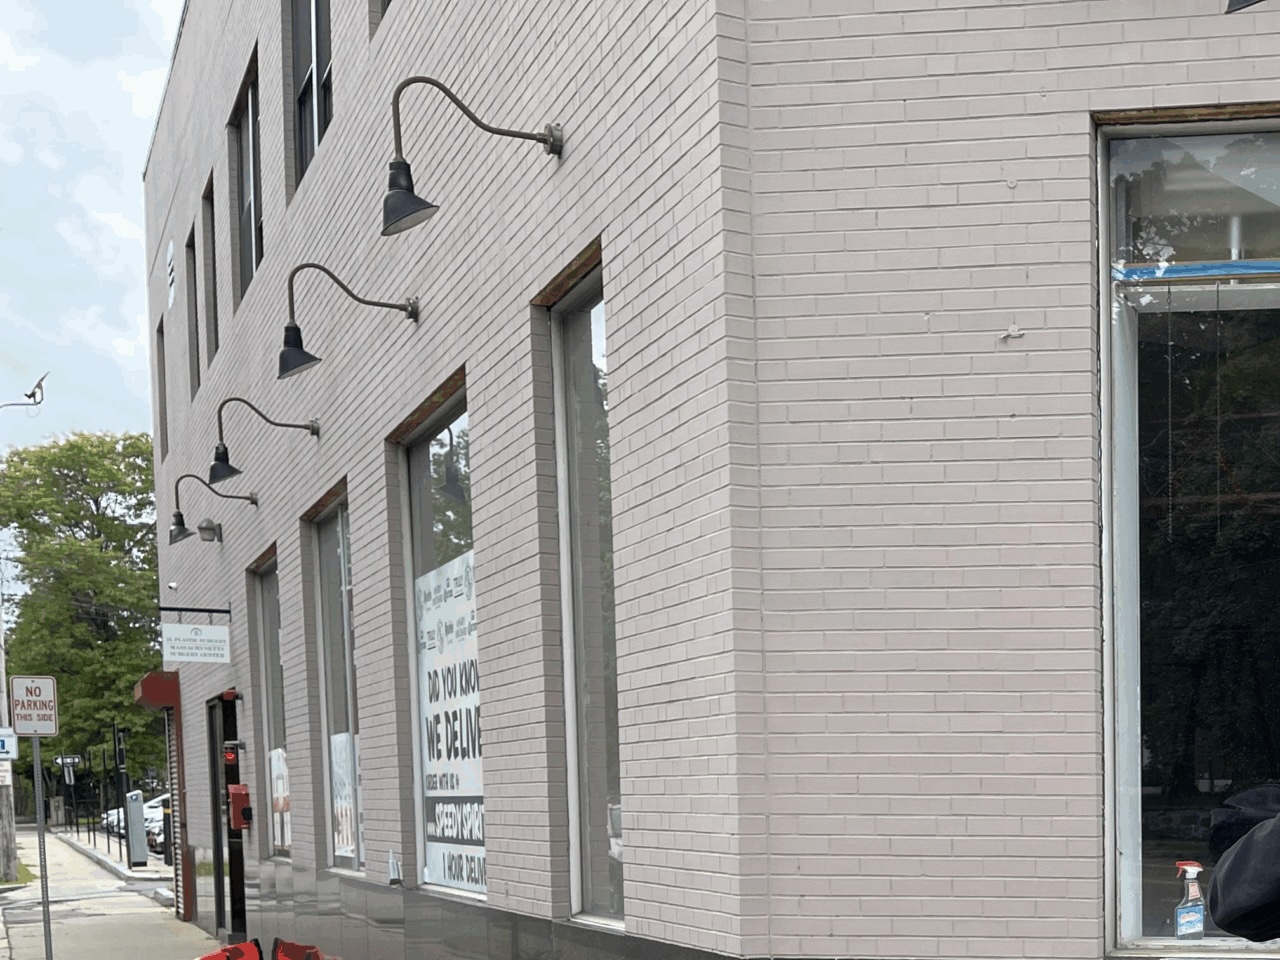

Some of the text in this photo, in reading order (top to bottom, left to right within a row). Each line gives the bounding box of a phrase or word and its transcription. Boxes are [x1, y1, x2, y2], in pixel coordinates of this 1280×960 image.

[26, 686, 41, 697] NO
[428, 669, 439, 703] DID
[441, 663, 456, 700] YOU
[14, 699, 54, 711] PARKING
[16, 713, 54, 721] THIS SIDE
[426, 713, 441, 761] WE
[447, 851, 464, 882] HOUR
